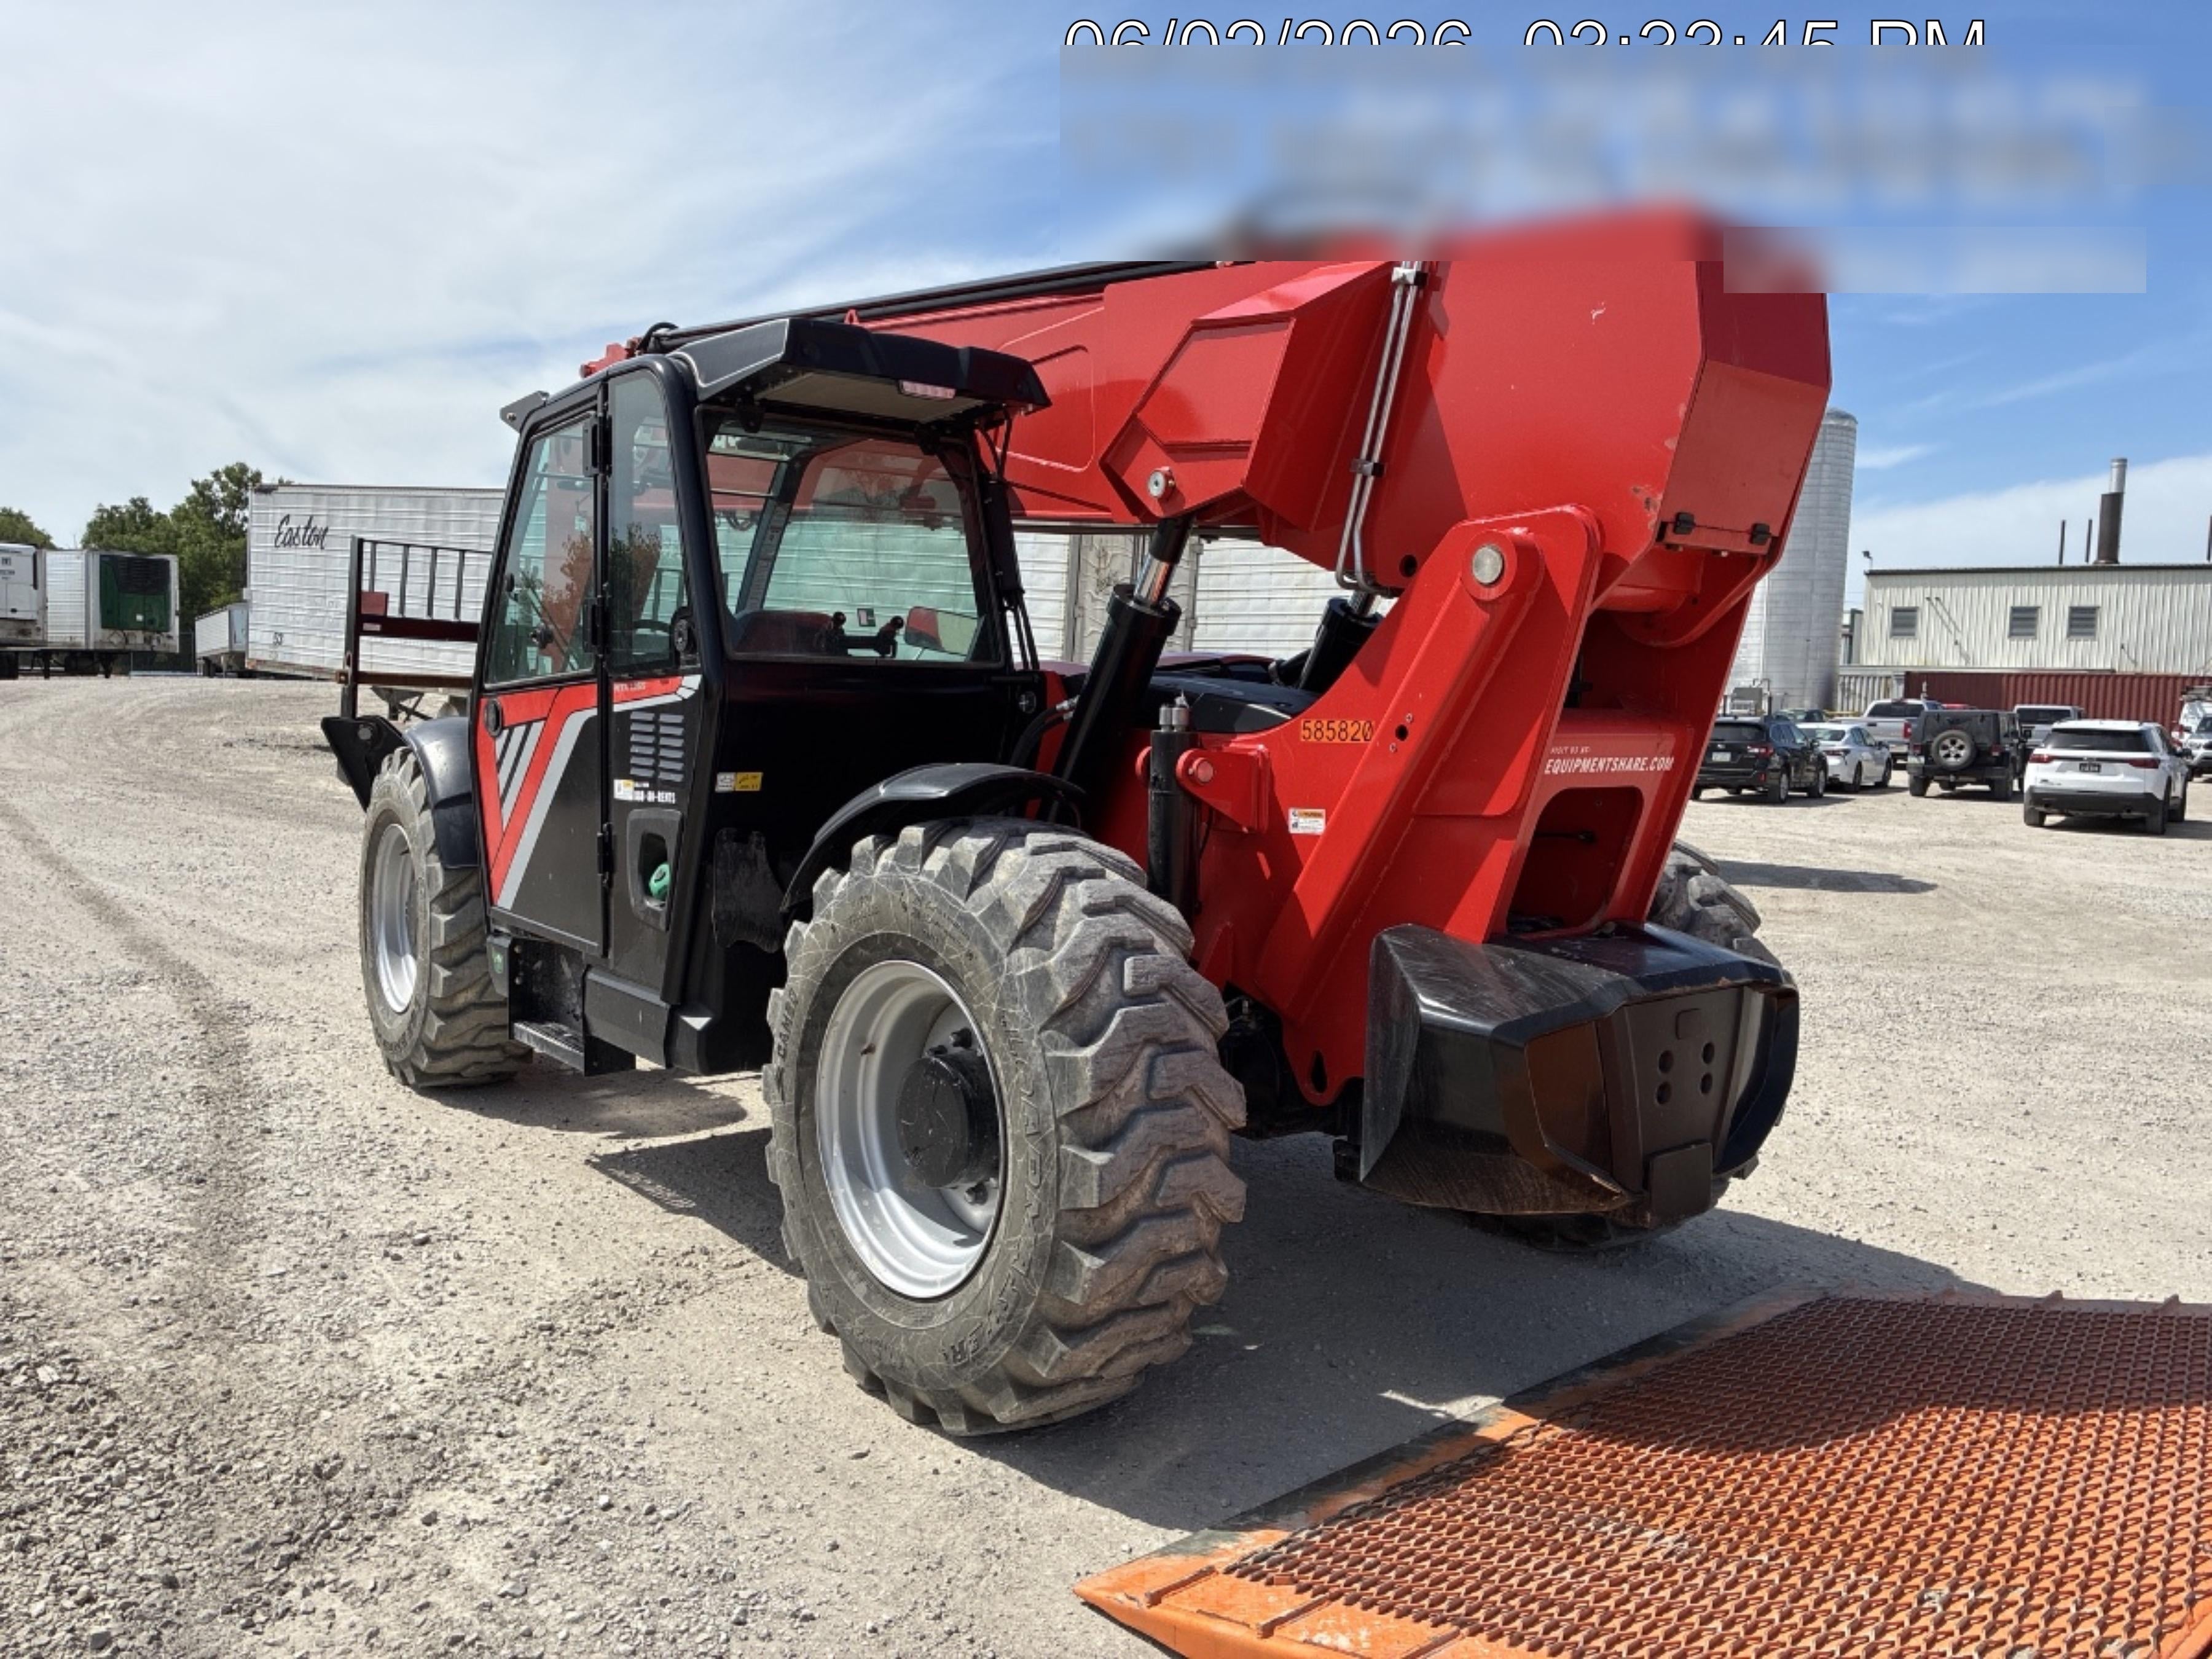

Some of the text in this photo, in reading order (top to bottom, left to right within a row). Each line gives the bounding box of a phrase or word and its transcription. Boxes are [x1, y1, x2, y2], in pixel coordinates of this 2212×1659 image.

[274, 514, 329, 550] Easton
[1302, 720, 1373, 742] 585820
[1544, 756, 1674, 775] EQUIPMENTSHARE.COM
